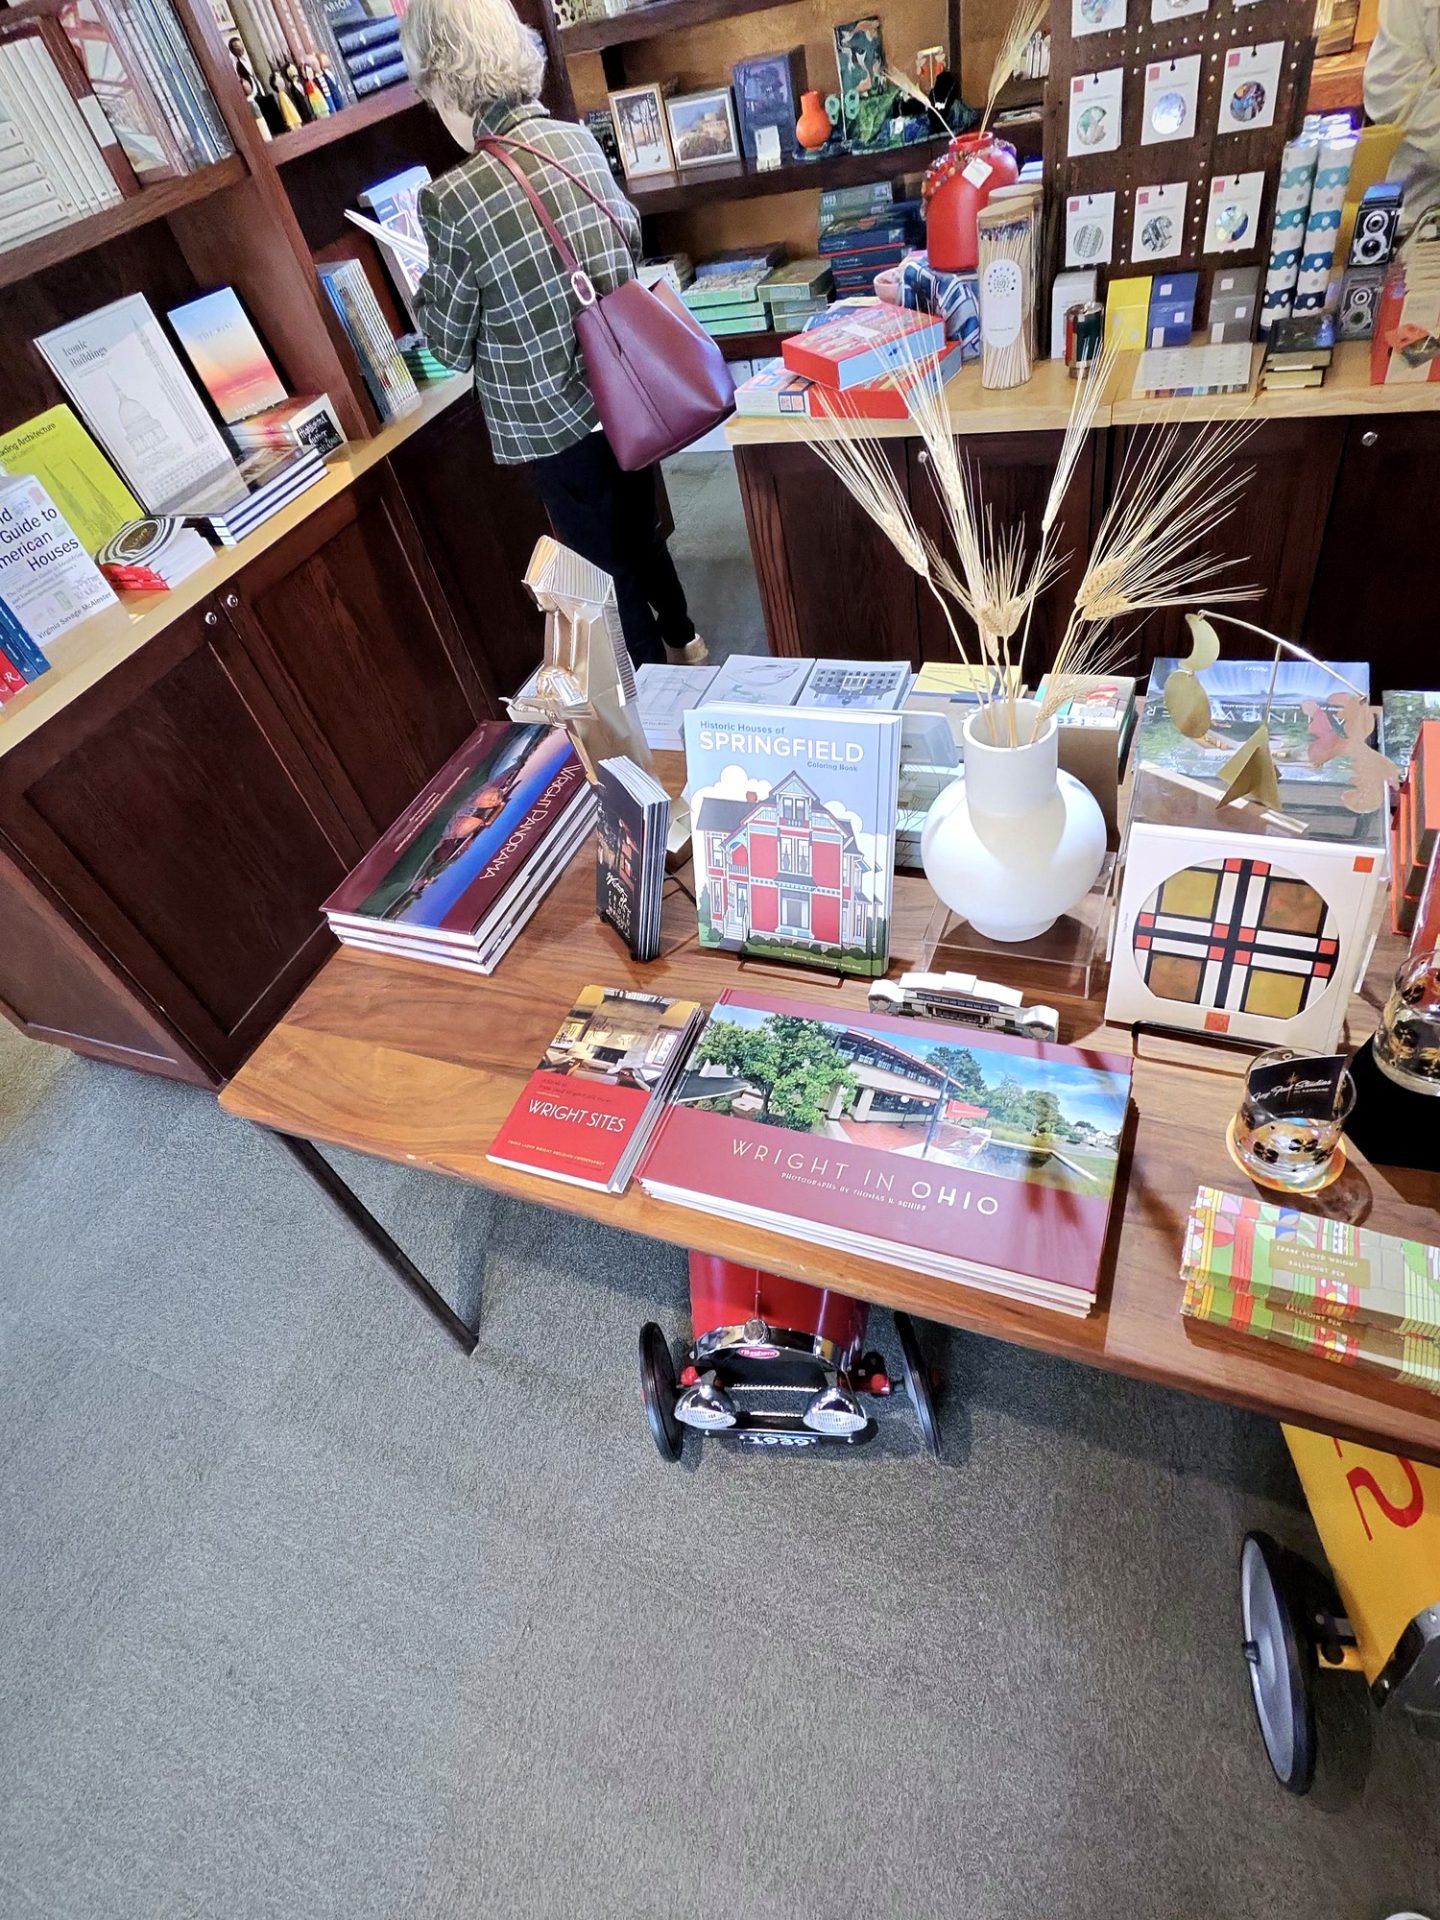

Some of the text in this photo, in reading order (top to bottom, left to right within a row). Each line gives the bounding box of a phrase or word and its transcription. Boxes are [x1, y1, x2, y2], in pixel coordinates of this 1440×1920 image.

[62, 340, 88, 357] Iconic
[69, 346, 108, 368] Buildings
[17, 423, 57, 447] Architecture
[0, 516, 41, 544] Guide
[40, 507, 57, 522] to
[0, 531, 54, 570] merican
[26, 538, 79, 572] Houses
[36, 621, 61, 639] Virginia
[59, 609, 82, 626] Savage
[700, 720, 785, 735] Historic Houses of
[699, 730, 865, 763] SPRINGFIELD
[807, 761, 858, 772] Coloring Book
[479, 763, 582, 881] WRIGHT PANORAMA
[1295, 1079, 1332, 1091] Studios
[528, 1099, 627, 1133] WRIGHT SITES
[732, 1138, 998, 1215] WRIGHT IN OHIO
[781, 1172, 837, 1190] PHOTOGRAPHS
[840, 1186, 850, 1194] BY
[853, 1189, 885, 1202] THOMAS
[898, 1200, 927, 1212] SCHIFF
[1276, 1245, 1358, 1268] FRANK LLOYD WRIGHT
[1288, 1260, 1329, 1273] BALLPOINT
[1285, 1303, 1343, 1327] BALLPOINT PEN
